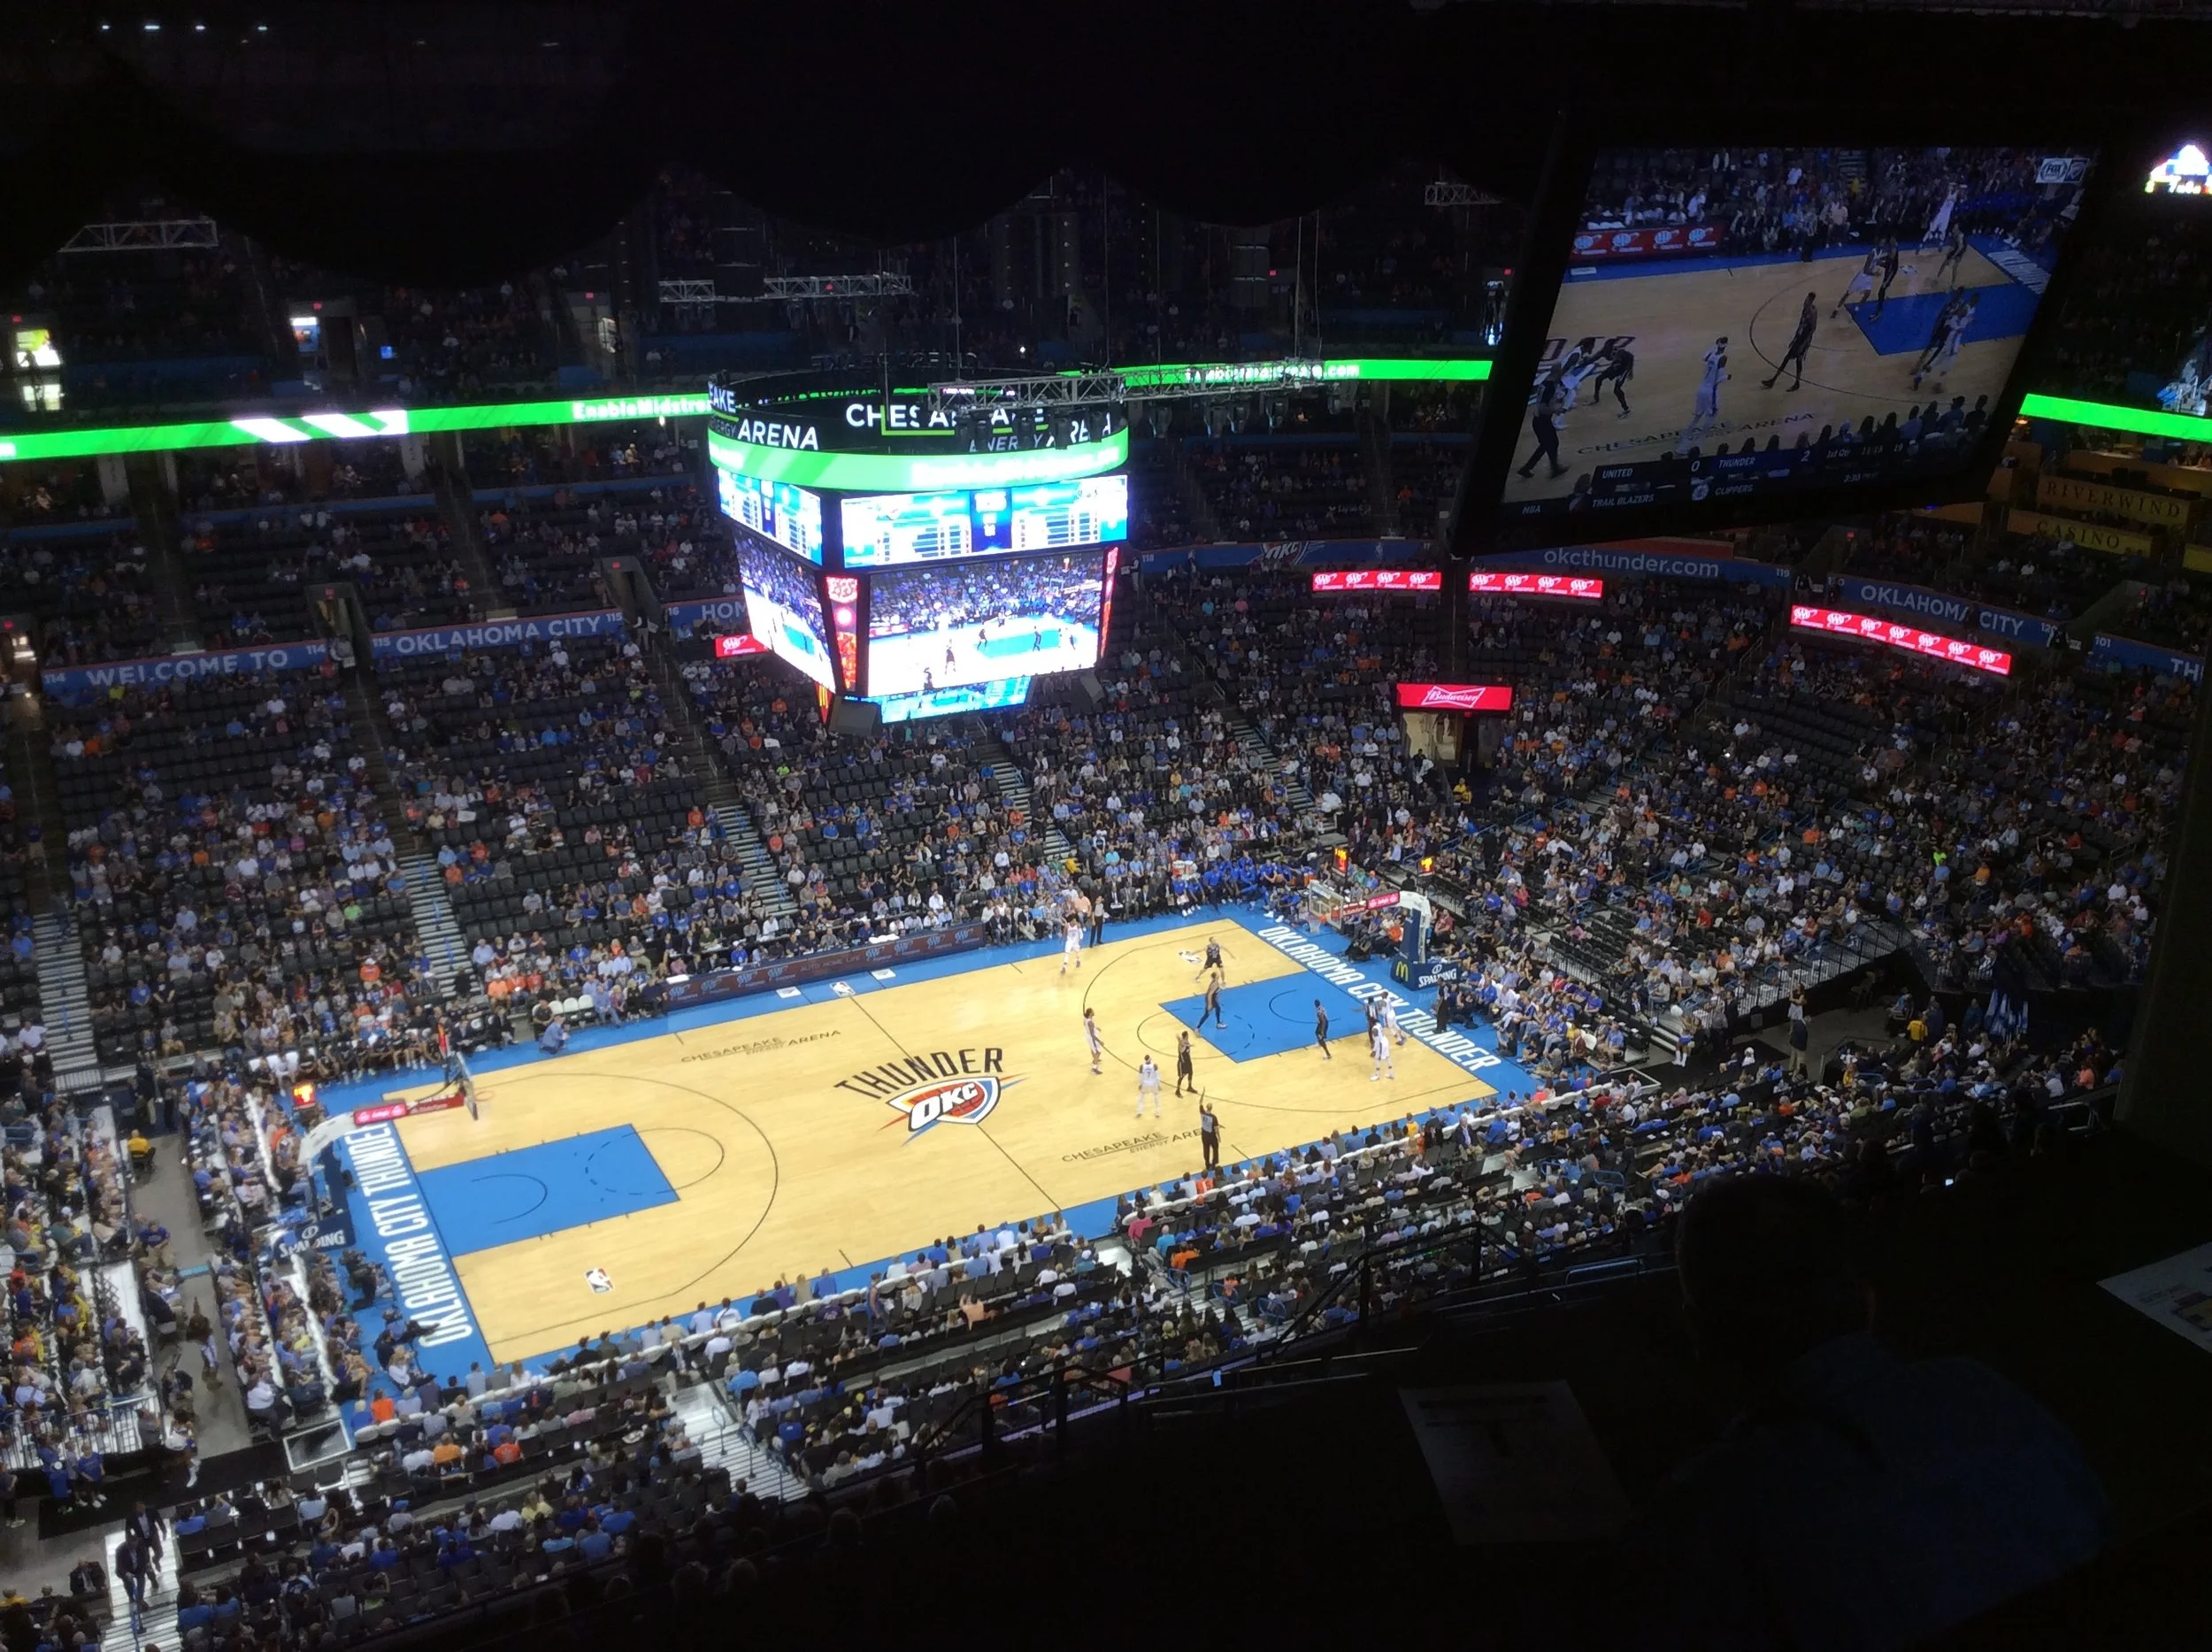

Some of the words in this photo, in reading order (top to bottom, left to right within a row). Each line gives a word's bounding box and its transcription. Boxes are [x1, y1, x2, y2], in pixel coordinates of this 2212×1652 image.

[738, 419, 819, 450] ARENA
[1691, 460, 1701, 473] 0
[1718, 456, 1755, 469] THUNDER
[1800, 449, 1811, 463] 2
[1601, 467, 1634, 480] UNITED
[1522, 504, 1541, 515] NBA
[1593, 497, 1616, 509] TRAIL
[1617, 493, 1655, 506] BLAZERS
[2047, 480, 2180, 518] RIVERWIND
[2037, 520, 2120, 549] CASINO
[1544, 546, 1719, 578] okcthunder.com
[1776, 567, 1791, 578] 119
[396, 622, 541, 655] OKLAHOMA
[548, 615, 601, 638] CITY
[1979, 611, 2025, 636] CITY
[2094, 635, 2111, 649] 101
[250, 649, 288, 670] TO
[1429, 690, 1479, 703] Budweiser
[1257, 926, 1365, 986] OKLAHOMA
[1348, 981, 1409, 1008] CITY
[1396, 1008, 1502, 1072] THUNDER
[681, 1036, 783, 1062] CHESAPEAKE
[788, 1030, 841, 1046] ARENA
[833, 1047, 1003, 1100] THUNDER
[908, 1081, 979, 1132] OKC
[344, 1122, 412, 1198] THUNDE
[1062, 1131, 1166, 1163] CHESAPEAKE
[368, 1194, 429, 1237] CITY
[384, 1233, 473, 1348] OKLAHOMA
